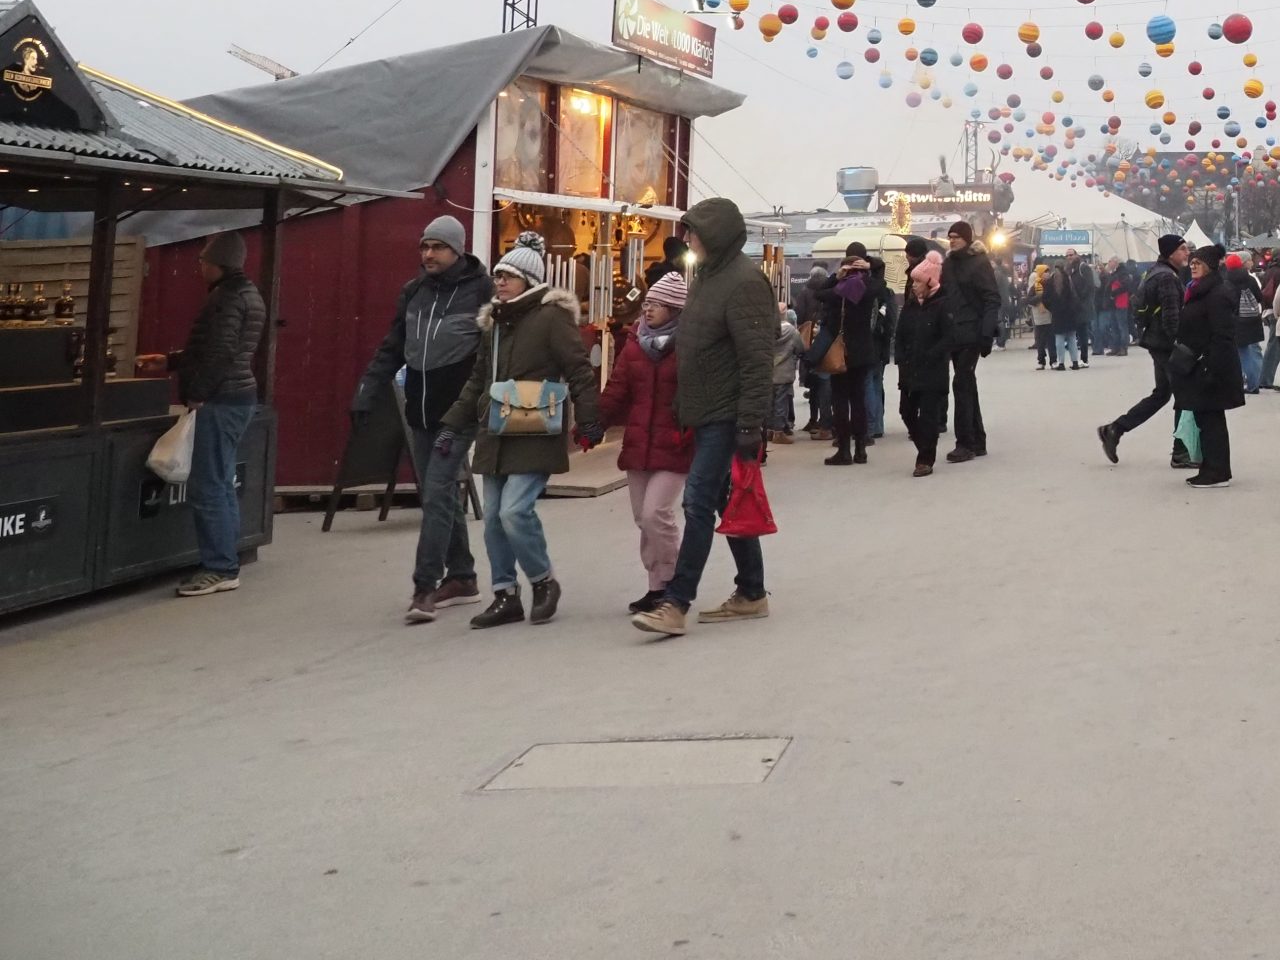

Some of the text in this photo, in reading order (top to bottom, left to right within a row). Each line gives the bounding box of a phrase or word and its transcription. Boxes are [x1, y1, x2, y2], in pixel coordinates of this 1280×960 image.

[637, 15, 650, 39] Die
[651, 20, 669, 46] Welt
[691, 36, 714, 67] Klänge
